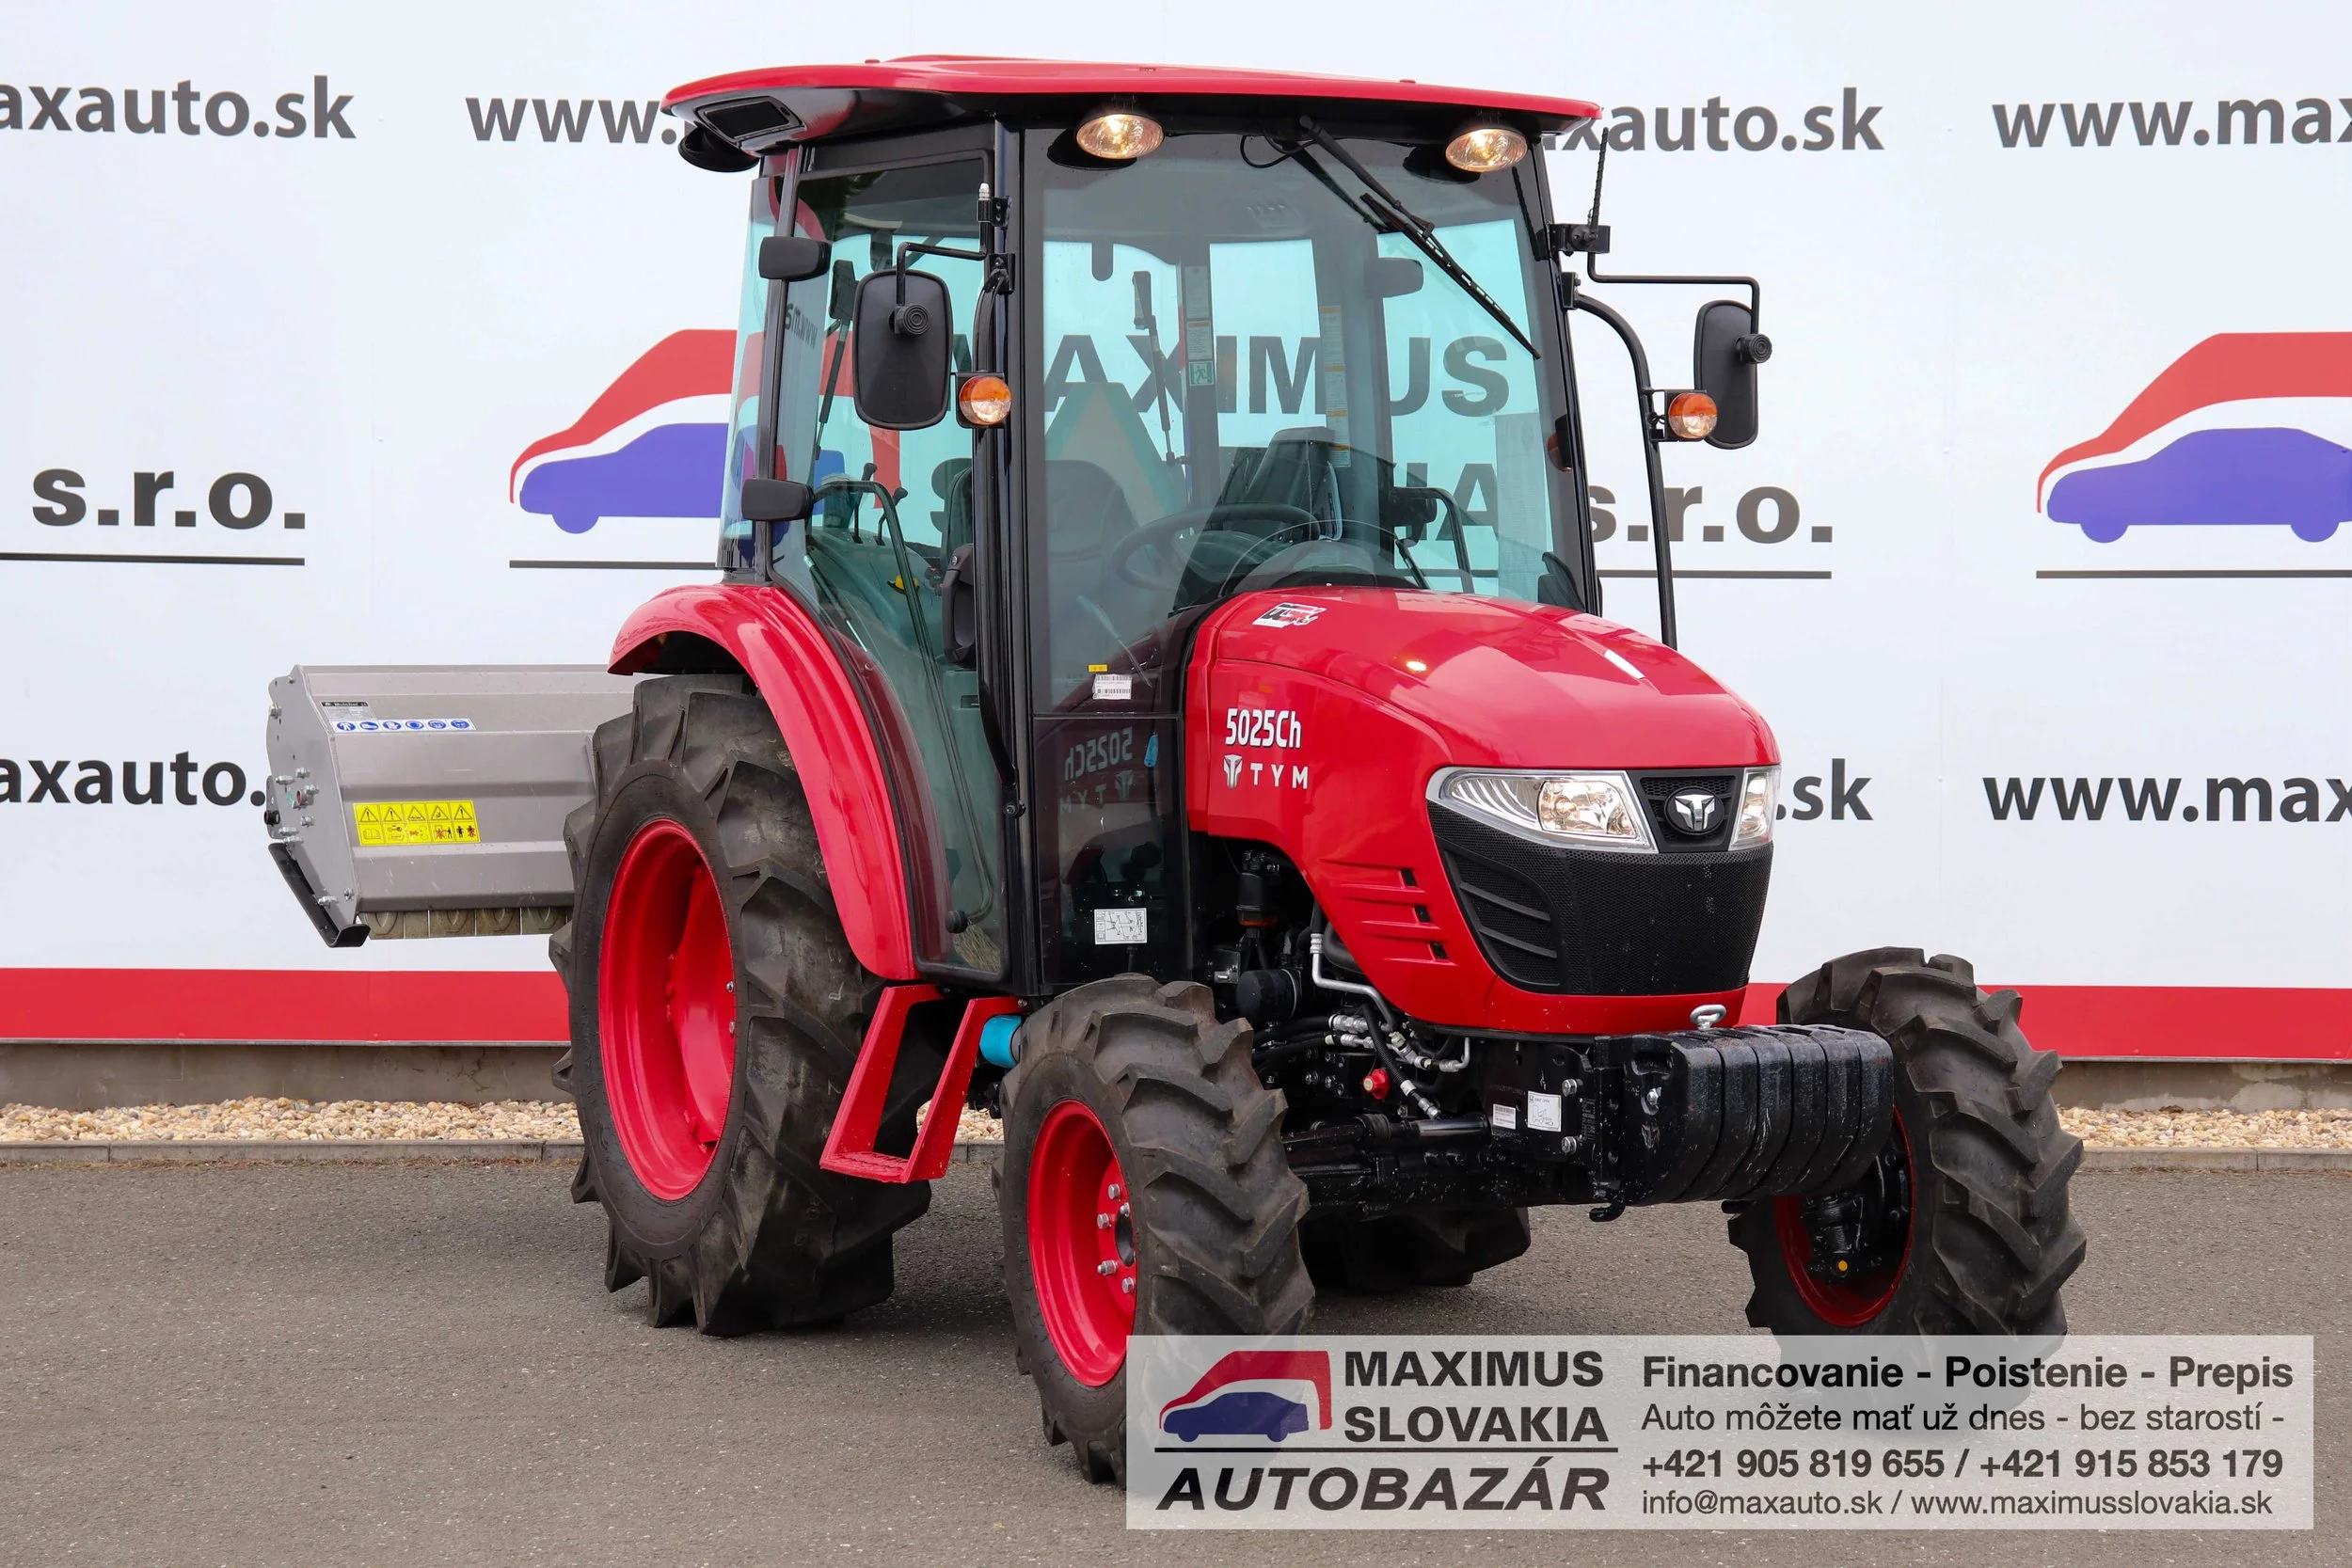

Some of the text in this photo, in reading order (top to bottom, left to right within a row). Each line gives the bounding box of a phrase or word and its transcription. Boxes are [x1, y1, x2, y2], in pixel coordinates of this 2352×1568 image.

[32, 468, 306, 531] s.r.o.
[1225, 708, 1301, 749] 5025Ch
[1249, 763, 1309, 789] TYM
